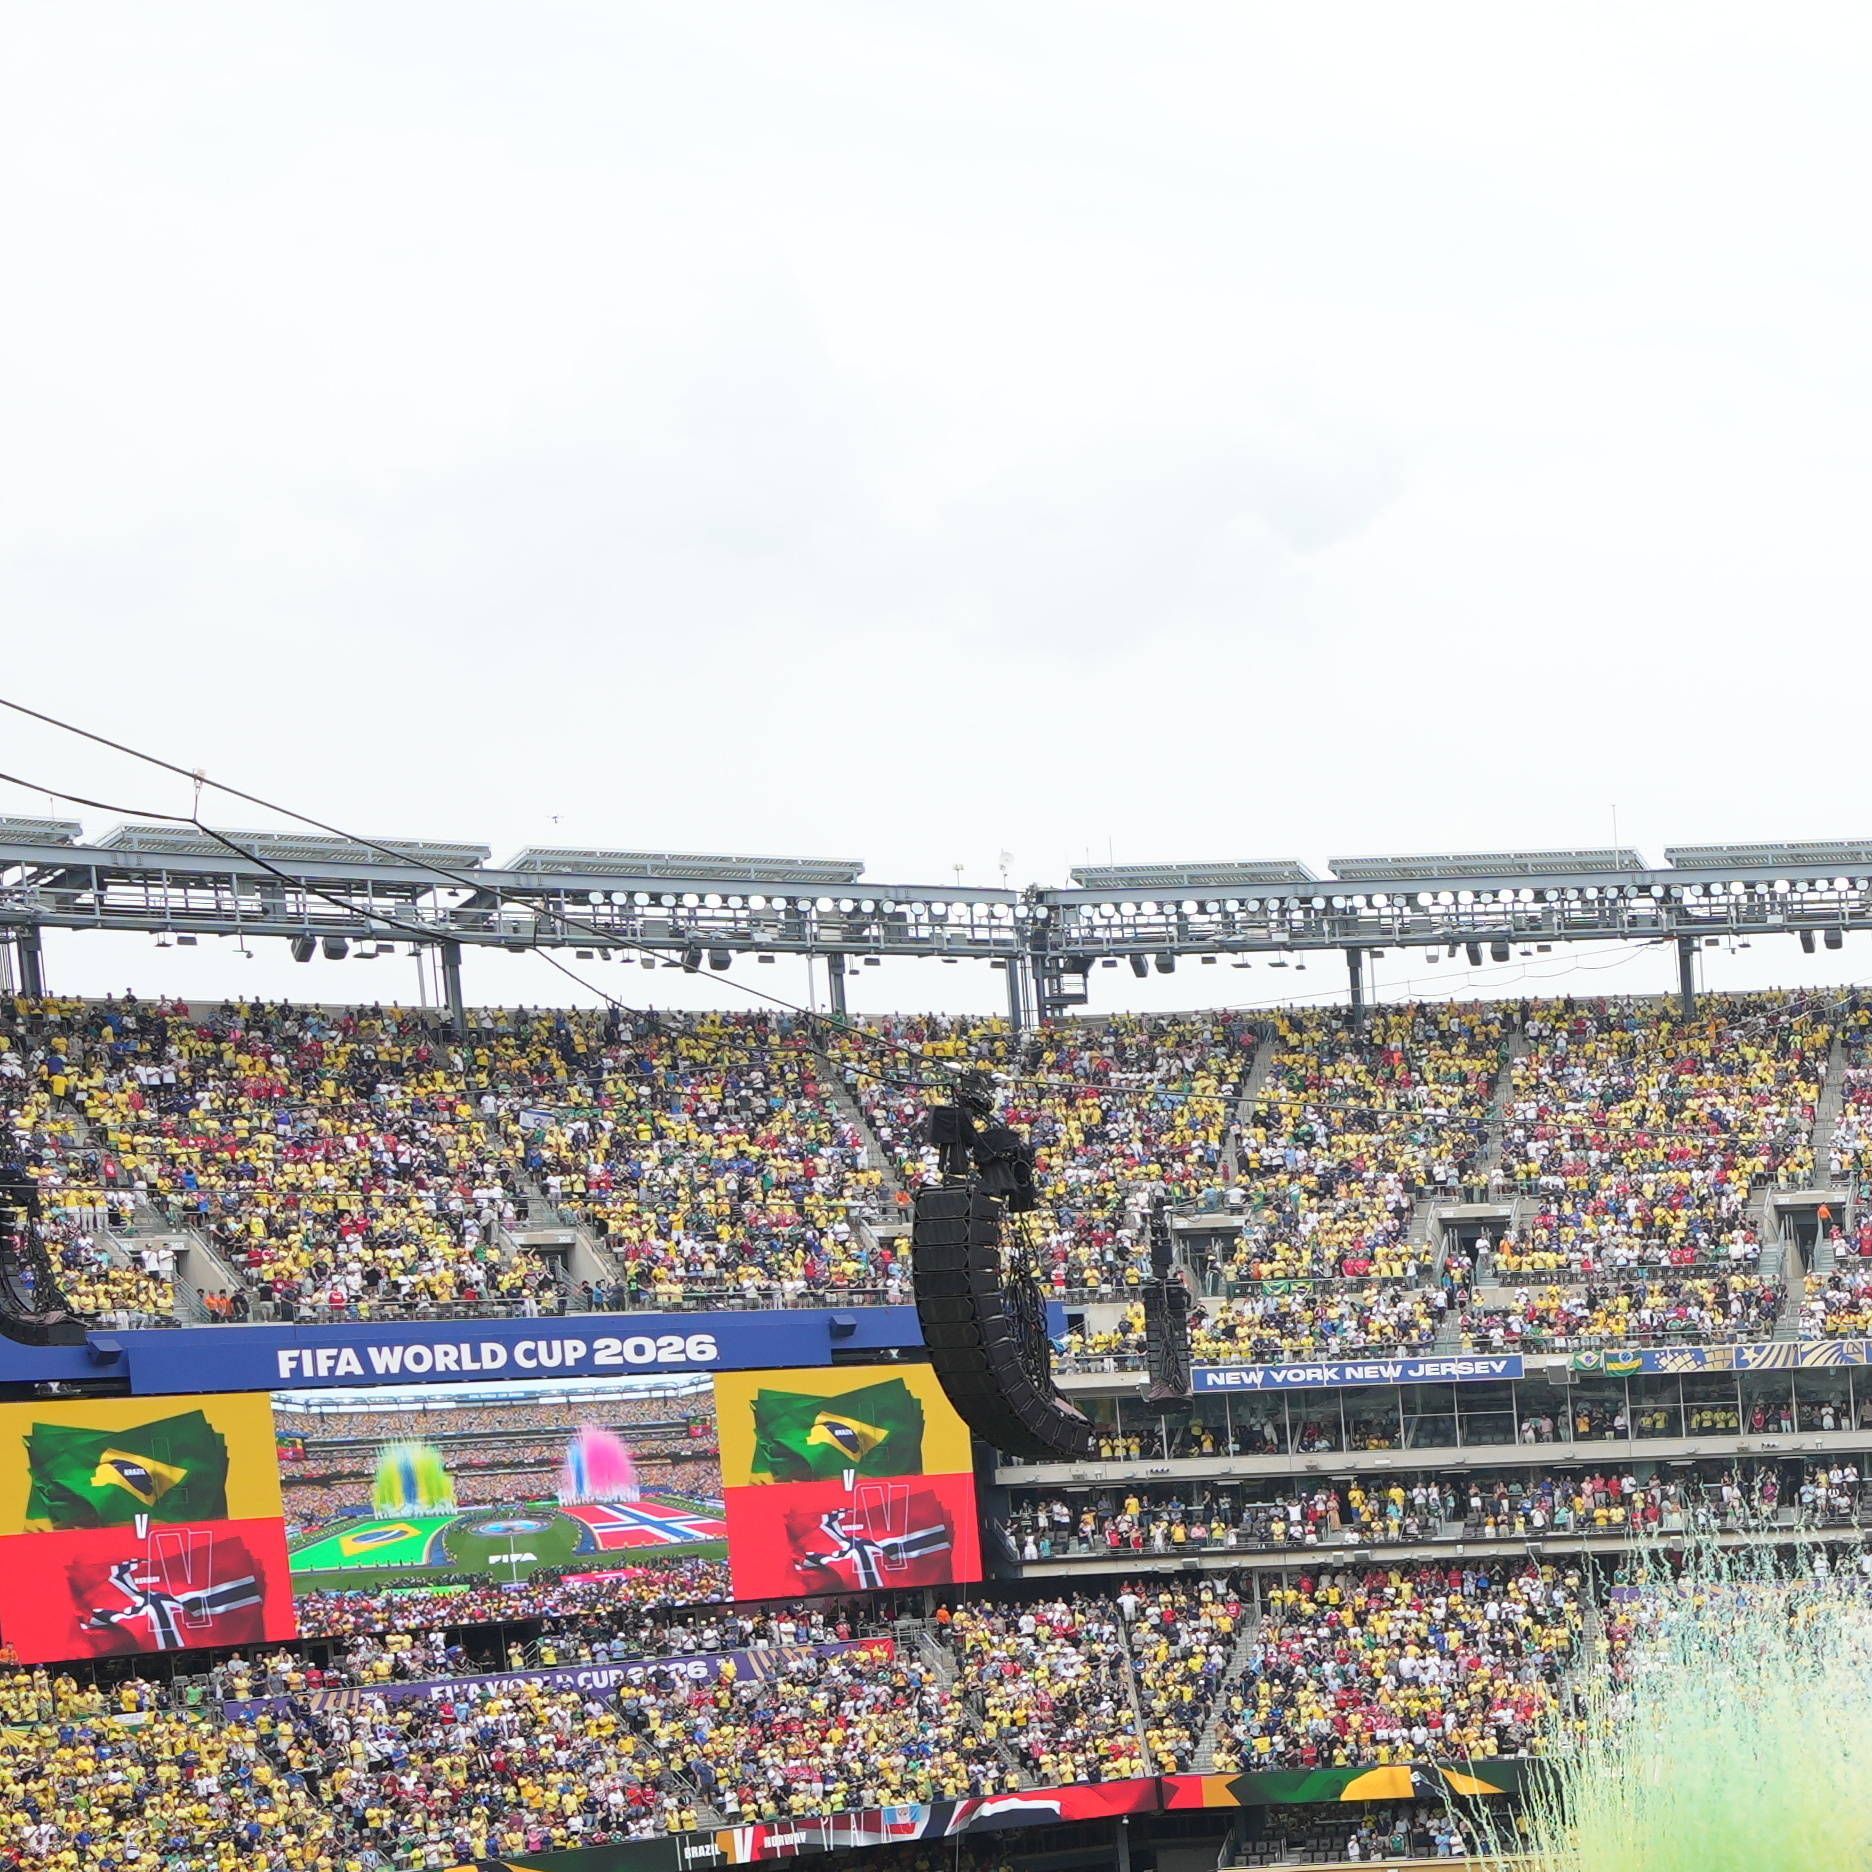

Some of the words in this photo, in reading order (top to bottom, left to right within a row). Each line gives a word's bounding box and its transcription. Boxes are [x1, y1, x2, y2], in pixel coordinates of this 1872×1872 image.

[277, 1348, 364, 1378] FIFA
[367, 1341, 507, 1374] WORLD
[513, 1338, 587, 1368] CUP
[593, 1334, 718, 1365] 2026
[1207, 1370, 1264, 1386] NEW
[1269, 1366, 1340, 1383] YORK
[1345, 1363, 1402, 1379] NEW
[1407, 1360, 1508, 1378] JERSEY
[843, 1468, 855, 1492] V
[134, 1513, 148, 1539] V
[684, 1842, 721, 1859] BRAZIL
[733, 1826, 754, 1865] V
